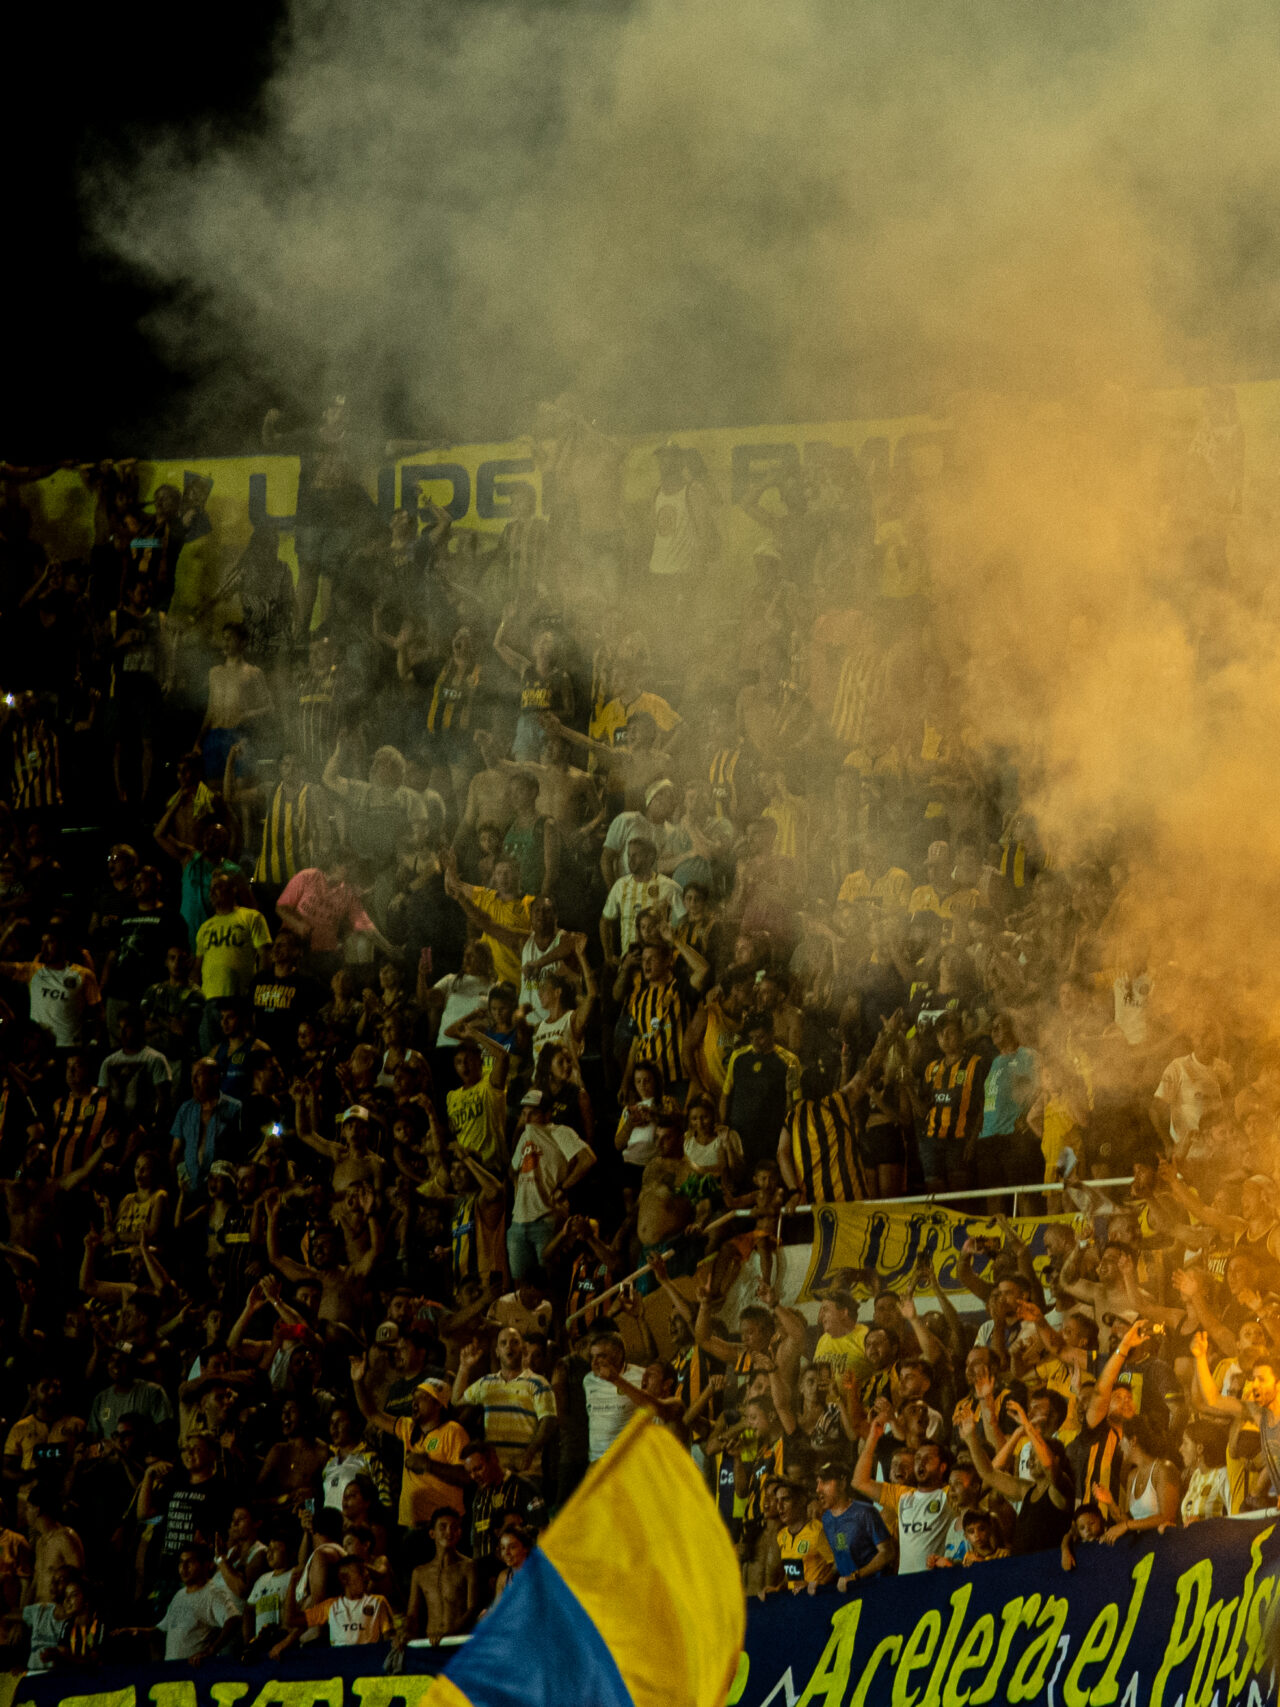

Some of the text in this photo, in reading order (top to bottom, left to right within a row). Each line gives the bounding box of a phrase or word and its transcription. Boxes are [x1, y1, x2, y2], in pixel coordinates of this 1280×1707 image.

[42, 987, 69, 1001] TCL
[578, 1281, 595, 1290] TCL
[902, 1522, 933, 1534] TCL
[783, 1564, 801, 1576] TCL
[343, 1623, 365, 1632] TCL
[792, 1583, 1069, 1707] Acelera
[1063, 1552, 1155, 1706] el
